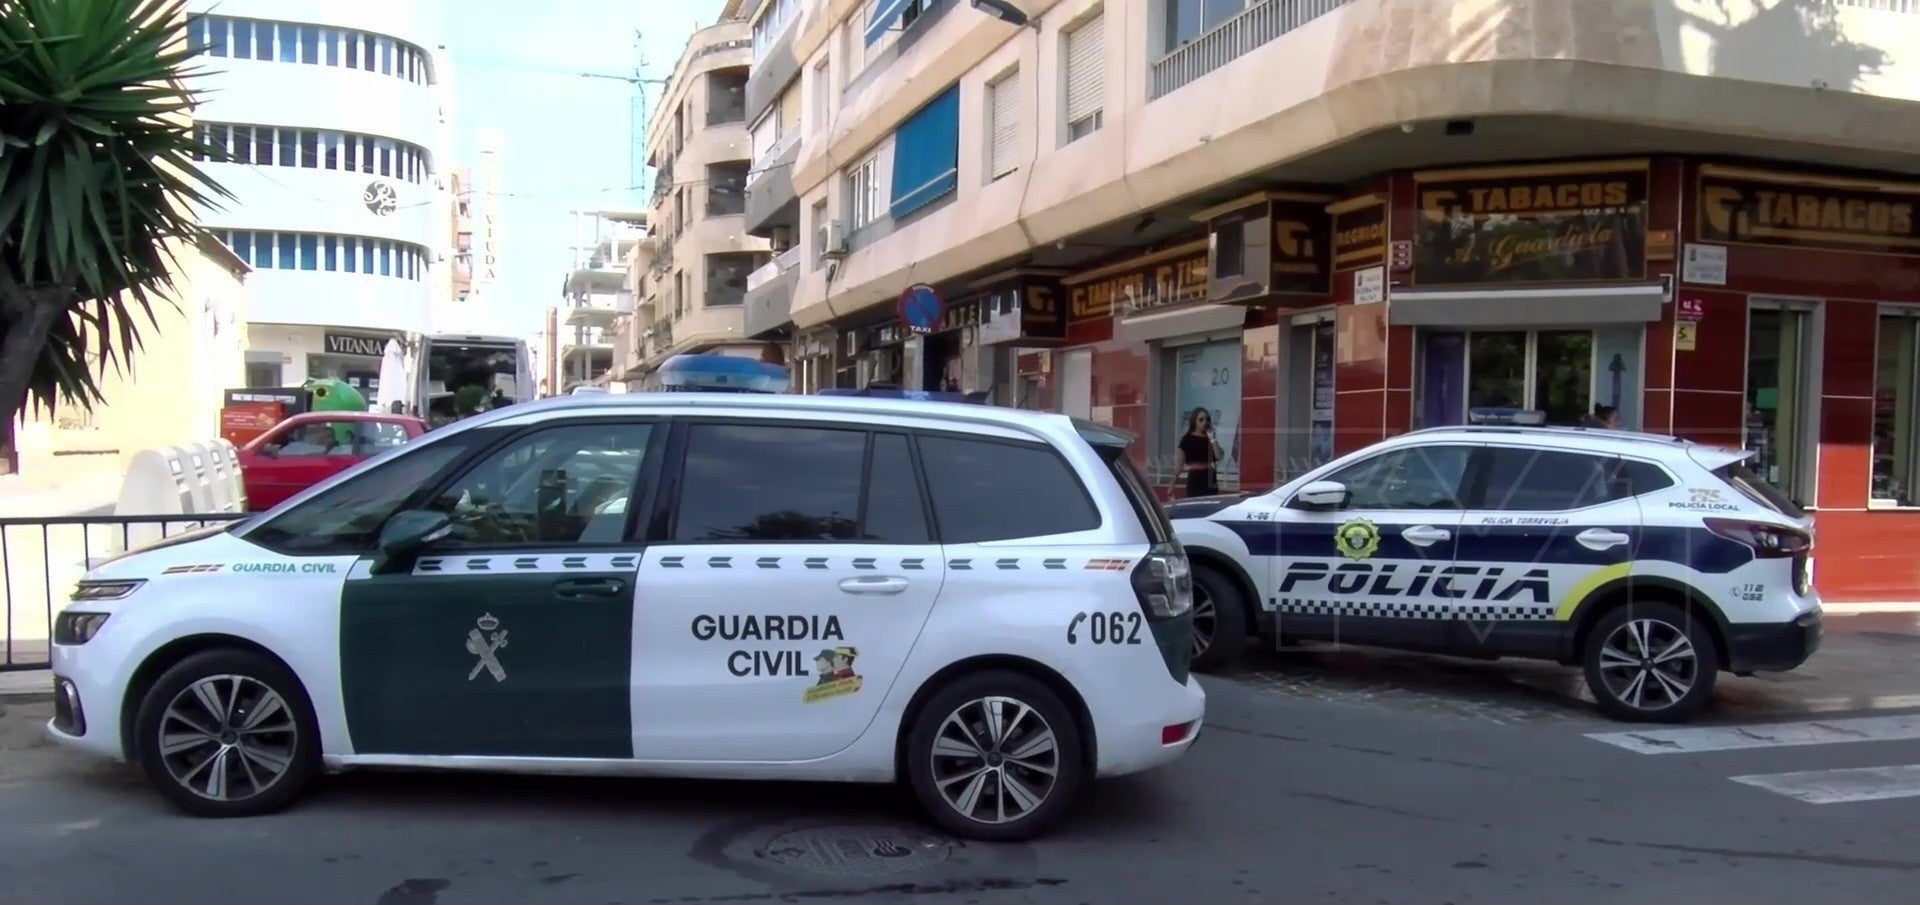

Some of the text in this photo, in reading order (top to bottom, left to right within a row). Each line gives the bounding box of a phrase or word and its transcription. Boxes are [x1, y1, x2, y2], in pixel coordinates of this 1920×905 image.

[1468, 181, 1628, 212] TABACOS
[1756, 190, 1912, 235] TABACOS
[909, 325, 932, 333] TAXI
[329, 335, 384, 356] VITANIA
[1708, 503, 1740, 512] LOCAL
[232, 563, 337, 573] GUARDIA CIVIL
[1278, 561, 1551, 603] POLICIA
[691, 614, 845, 641] GUARDIA
[1091, 611, 1142, 645] 062
[727, 650, 809, 677] CIVIL
